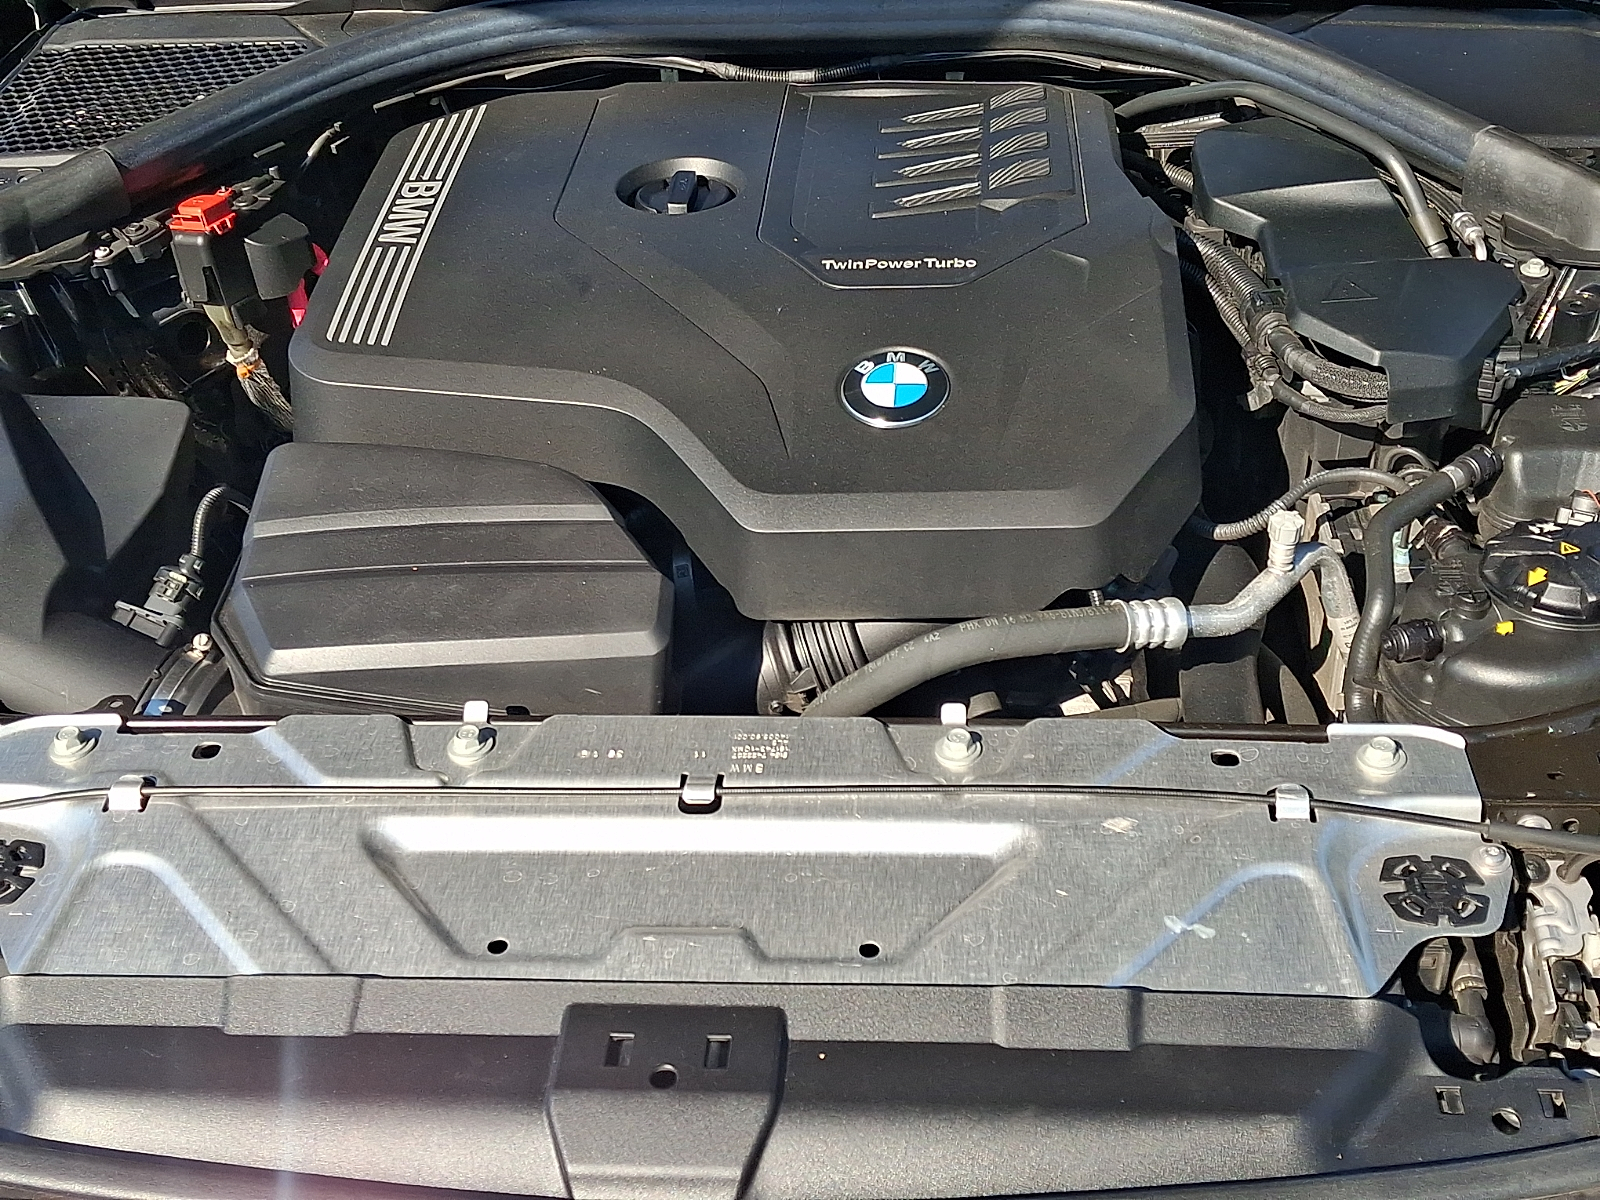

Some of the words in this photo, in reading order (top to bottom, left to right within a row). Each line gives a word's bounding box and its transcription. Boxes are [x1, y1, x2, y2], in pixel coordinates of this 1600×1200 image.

[378, 180, 443, 244] BMW
[821, 258, 922, 270] TwinPower
[923, 257, 977, 269] Turbo
[854, 352, 940, 375] BMW
